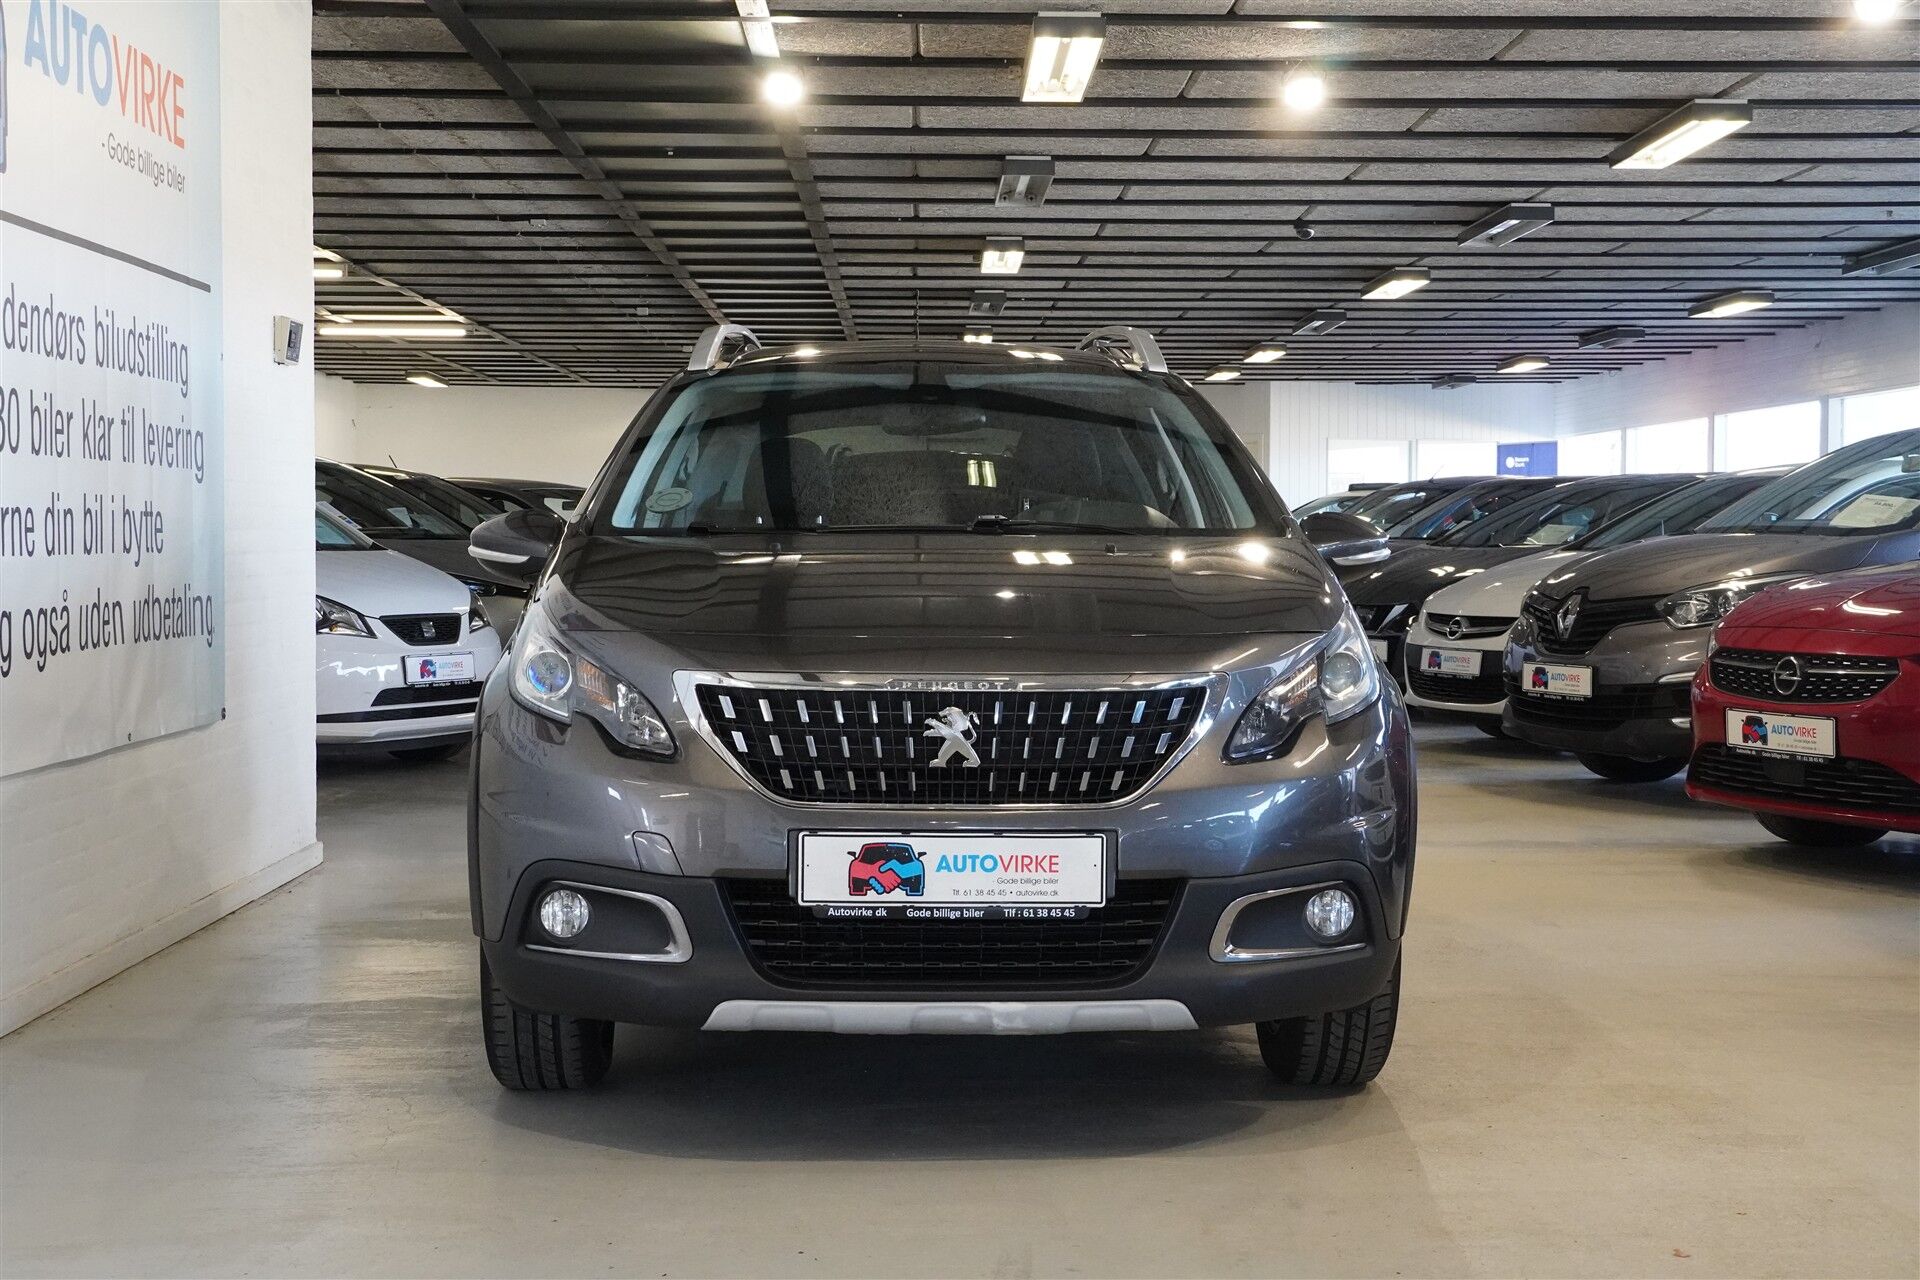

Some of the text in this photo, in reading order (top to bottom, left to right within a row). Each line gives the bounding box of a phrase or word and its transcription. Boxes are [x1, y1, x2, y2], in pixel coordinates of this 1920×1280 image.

[24, 0, 185, 149] AUTOVIRKE
[107, 132, 136, 169] Gode
[137, 146, 165, 188] billige
[166, 161, 186, 194] biler
[94, 304, 190, 399] biludstilling
[30, 388, 74, 458] biler
[81, 397, 115, 462] klar
[120, 405, 135, 464] til
[142, 407, 205, 484] levering
[44, 491, 74, 558] din
[83, 492, 103, 556] bil
[111, 494, 115, 554] i
[122, 494, 164, 568] bytte
[22, 589, 71, 673] også
[79, 587, 125, 652] uden
[133, 583, 214, 649] udbetaling
[901, 680, 1005, 691] PEUGEOT
[1551, 673, 1580, 682] AUTOVIRKE
[1771, 724, 1817, 738] AUTOVIRKE
[935, 854, 1060, 873] AUTOVIRKE
[996, 877, 1019, 885] Gode
[1020, 877, 1042, 886] billige
[1043, 877, 1059, 885] biler
[1015, 888, 1059, 897] autovirke.dk
[827, 907, 873, 917] Autovirke
[875, 907, 887, 917] dk
[906, 908, 931, 918] Gode
[933, 908, 961, 919] billige
[963, 908, 985, 918] biler
[1003, 908, 1015, 918] Tlf
[1023, 908, 1034, 918] 61
[1037, 908, 1048, 918] 38
[1050, 908, 1061, 918] 45
[1063, 908, 1075, 918] 45
